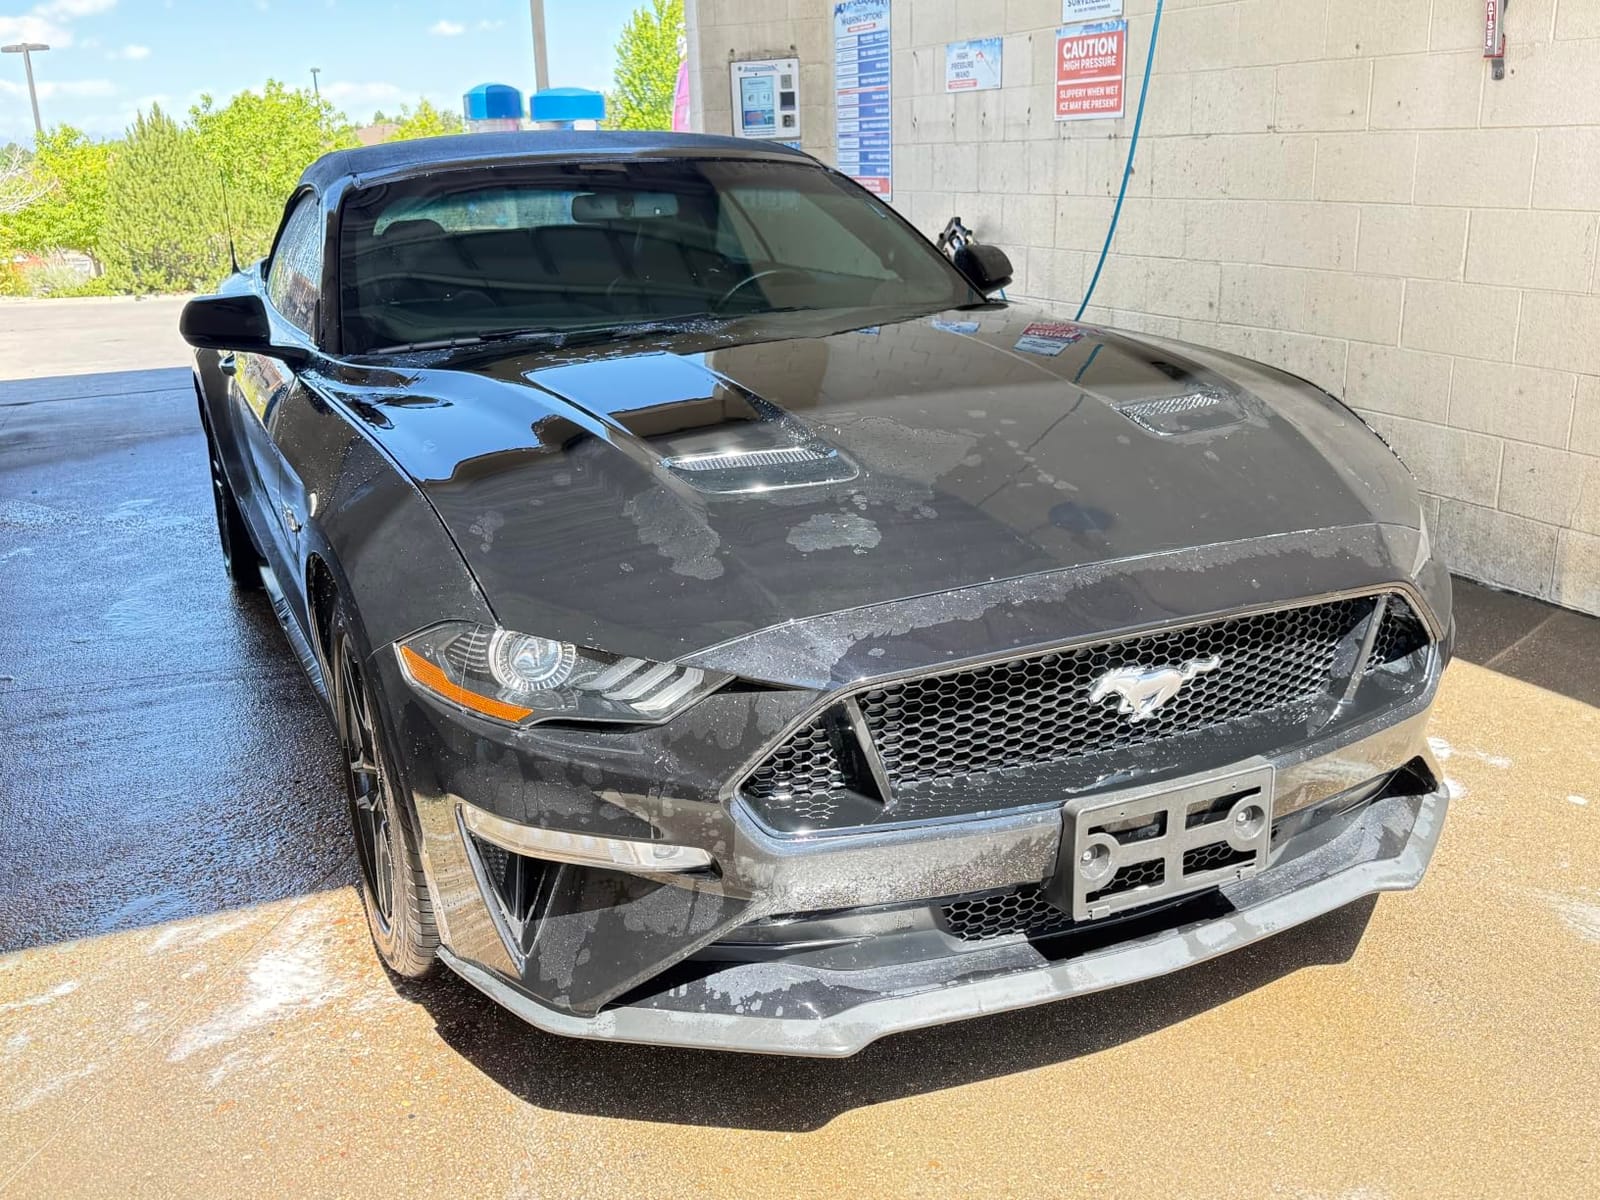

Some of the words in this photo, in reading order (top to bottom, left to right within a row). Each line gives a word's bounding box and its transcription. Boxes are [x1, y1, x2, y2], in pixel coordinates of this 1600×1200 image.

[1063, 35, 1117, 59] CAUTION
[1063, 60, 1080, 71] HIGH
[1081, 56, 1117, 69] PRESSURE
[1060, 88, 1086, 98] SLIPPERY
[1087, 86, 1105, 97] WHEN
[1105, 85, 1118, 95] WET
[1060, 101, 1070, 111] ICE
[1070, 101, 1081, 110] MAY
[1082, 100, 1091, 109] BE
[1091, 98, 1117, 109] PRESENT
